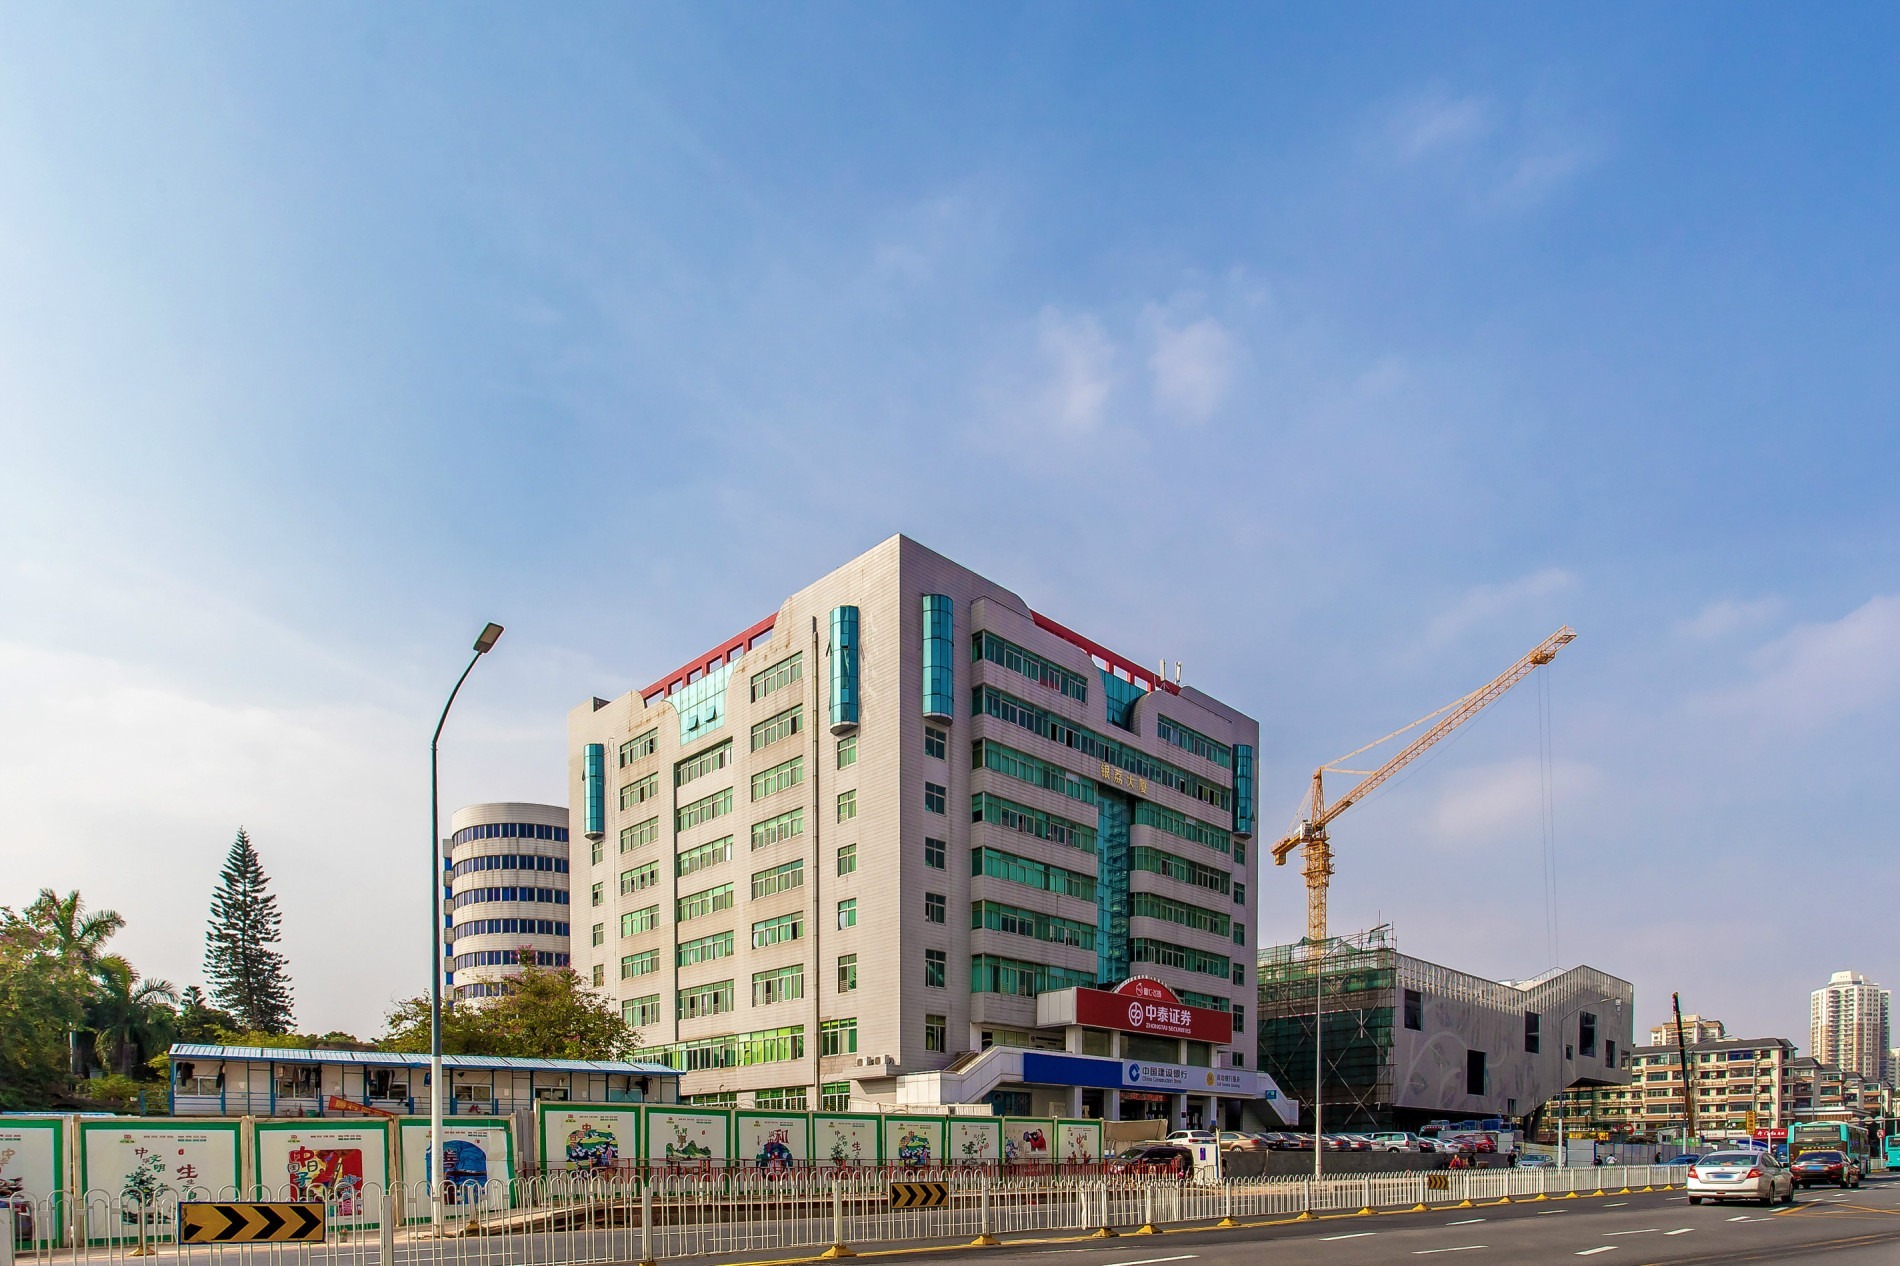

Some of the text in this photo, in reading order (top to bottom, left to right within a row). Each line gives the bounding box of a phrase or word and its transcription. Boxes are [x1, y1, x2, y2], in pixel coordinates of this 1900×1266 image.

[1145, 1004, 1192, 1026] 中泰证券
[1145, 1022, 1192, 1034] ZHONGTAI SECURITIES
[1142, 1066, 1188, 1080] 中国建设银行
